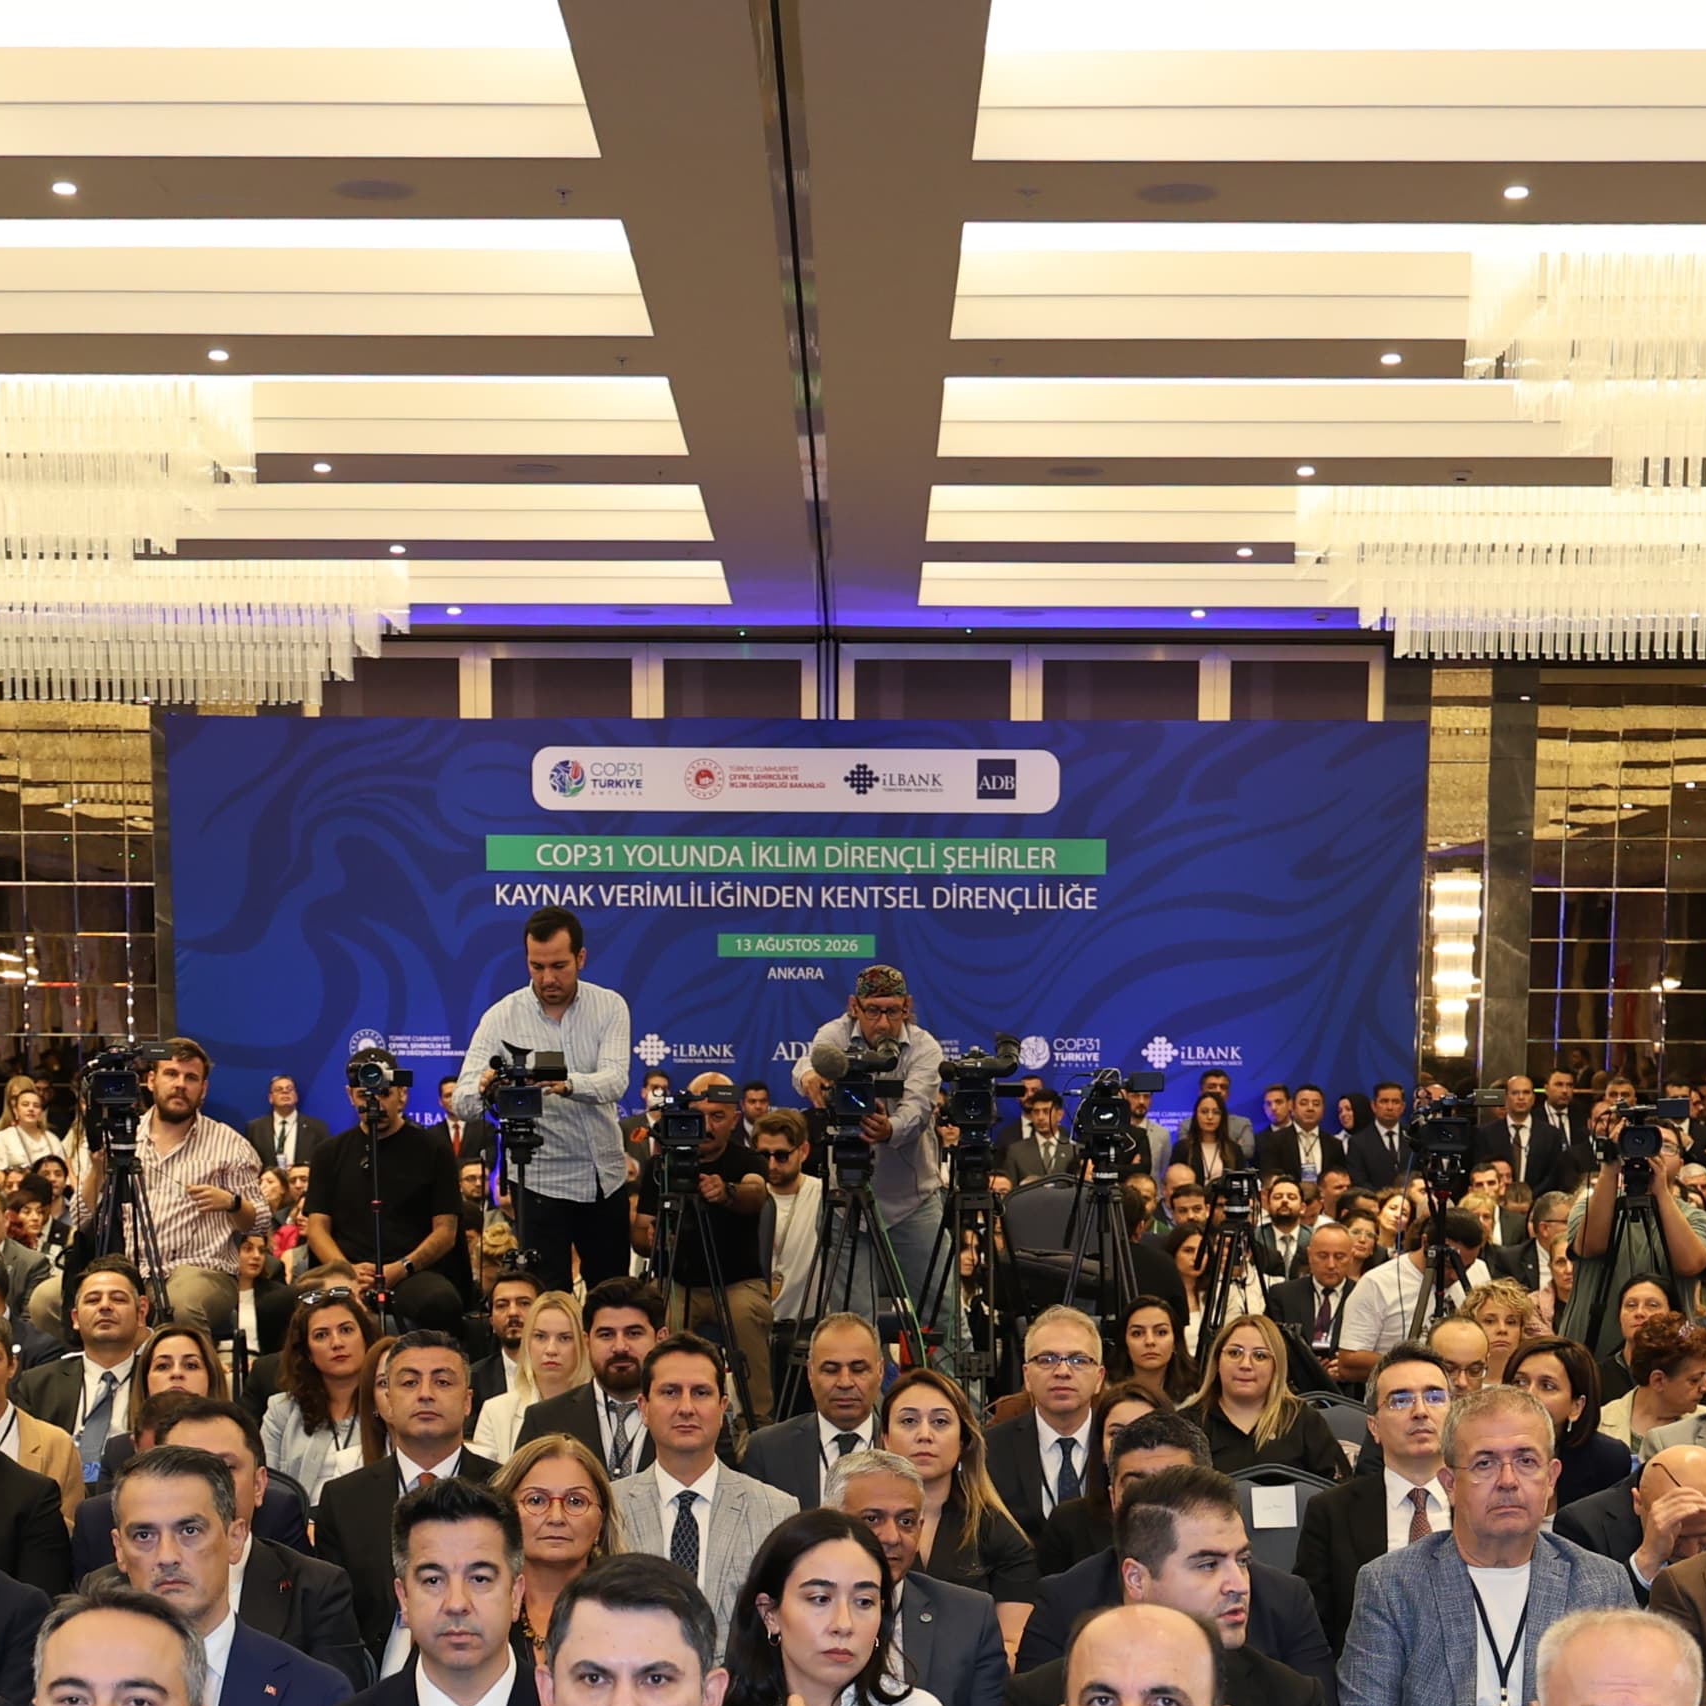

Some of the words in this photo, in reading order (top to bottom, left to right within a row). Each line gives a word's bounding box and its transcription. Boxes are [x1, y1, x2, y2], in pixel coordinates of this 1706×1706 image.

[590, 762, 643, 777] COP31
[978, 775, 1015, 790] ADB
[536, 843, 614, 867] COP31
[622, 844, 744, 868] YOLUNDA
[751, 841, 817, 868] İKLİM
[824, 842, 936, 874] DİRENÇLİ
[943, 842, 1056, 874] ŞEHİRLER
[495, 883, 595, 906] KAYNAK
[598, 881, 813, 908] VERİMLİLİĞİNDEN
[821, 885, 926, 909] KENTSEL
[933, 882, 1098, 915] DİRENÇLİLİĞE
[735, 938, 752, 951] 13
[755, 936, 821, 952] AĞUSTOS
[824, 939, 859, 952] 2026
[767, 966, 824, 979] ANKARA
[1053, 1038, 1101, 1051] COP31
